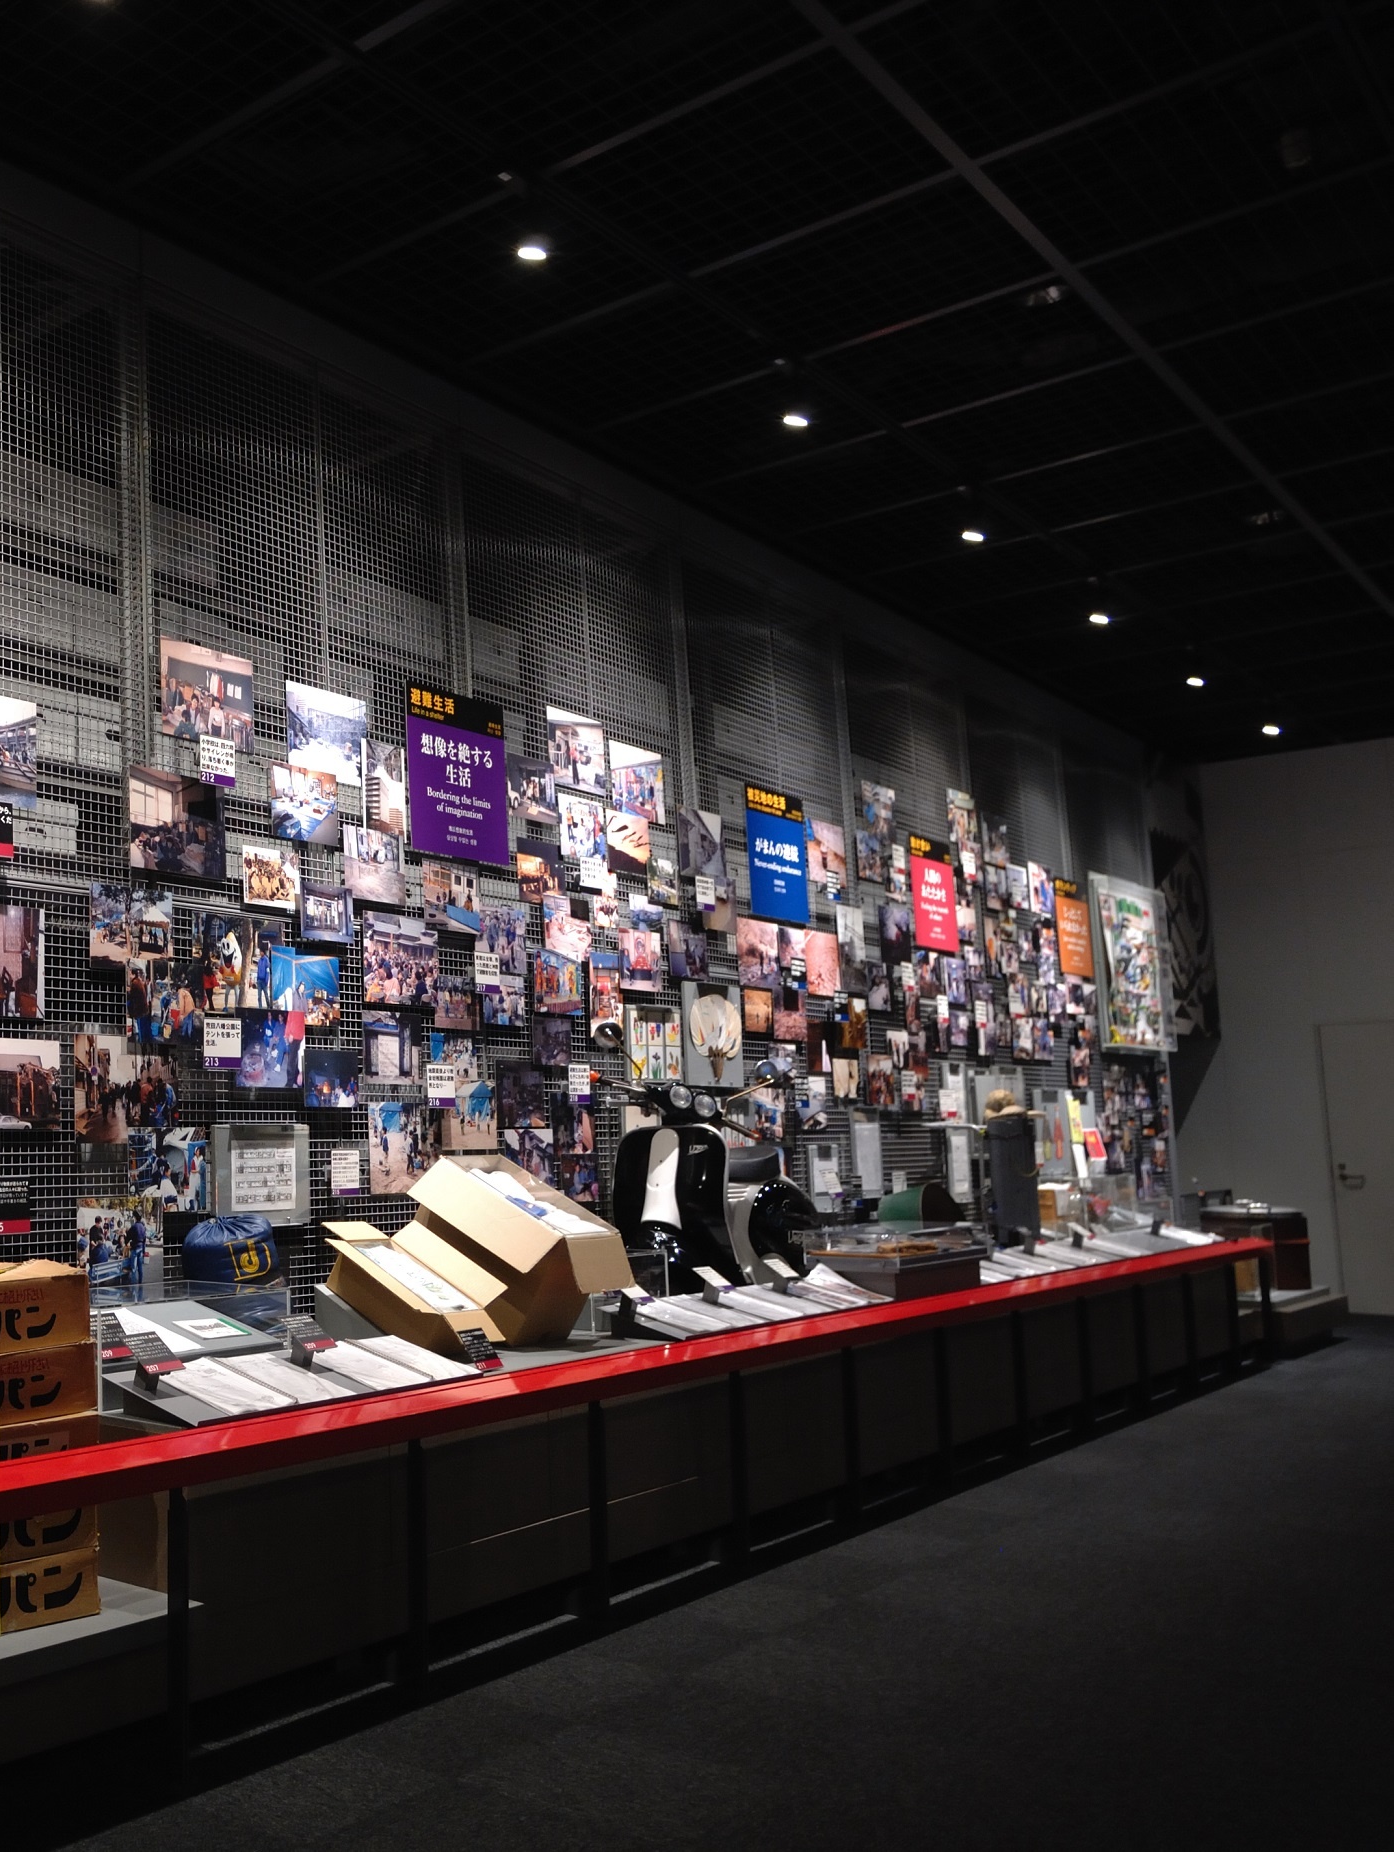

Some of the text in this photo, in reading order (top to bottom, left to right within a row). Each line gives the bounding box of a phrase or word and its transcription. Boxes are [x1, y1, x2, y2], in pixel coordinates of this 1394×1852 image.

[410, 687, 455, 715] 避難生活
[420, 732, 493, 769] 想像を絶する
[201, 772, 215, 783] 212
[445, 763, 471, 789] 生活
[426, 786, 491, 810] Bordering the limits
[436, 802, 483, 820] of imagination
[205, 1057, 220, 1067] 213
[429, 1098, 440, 1106] 216
